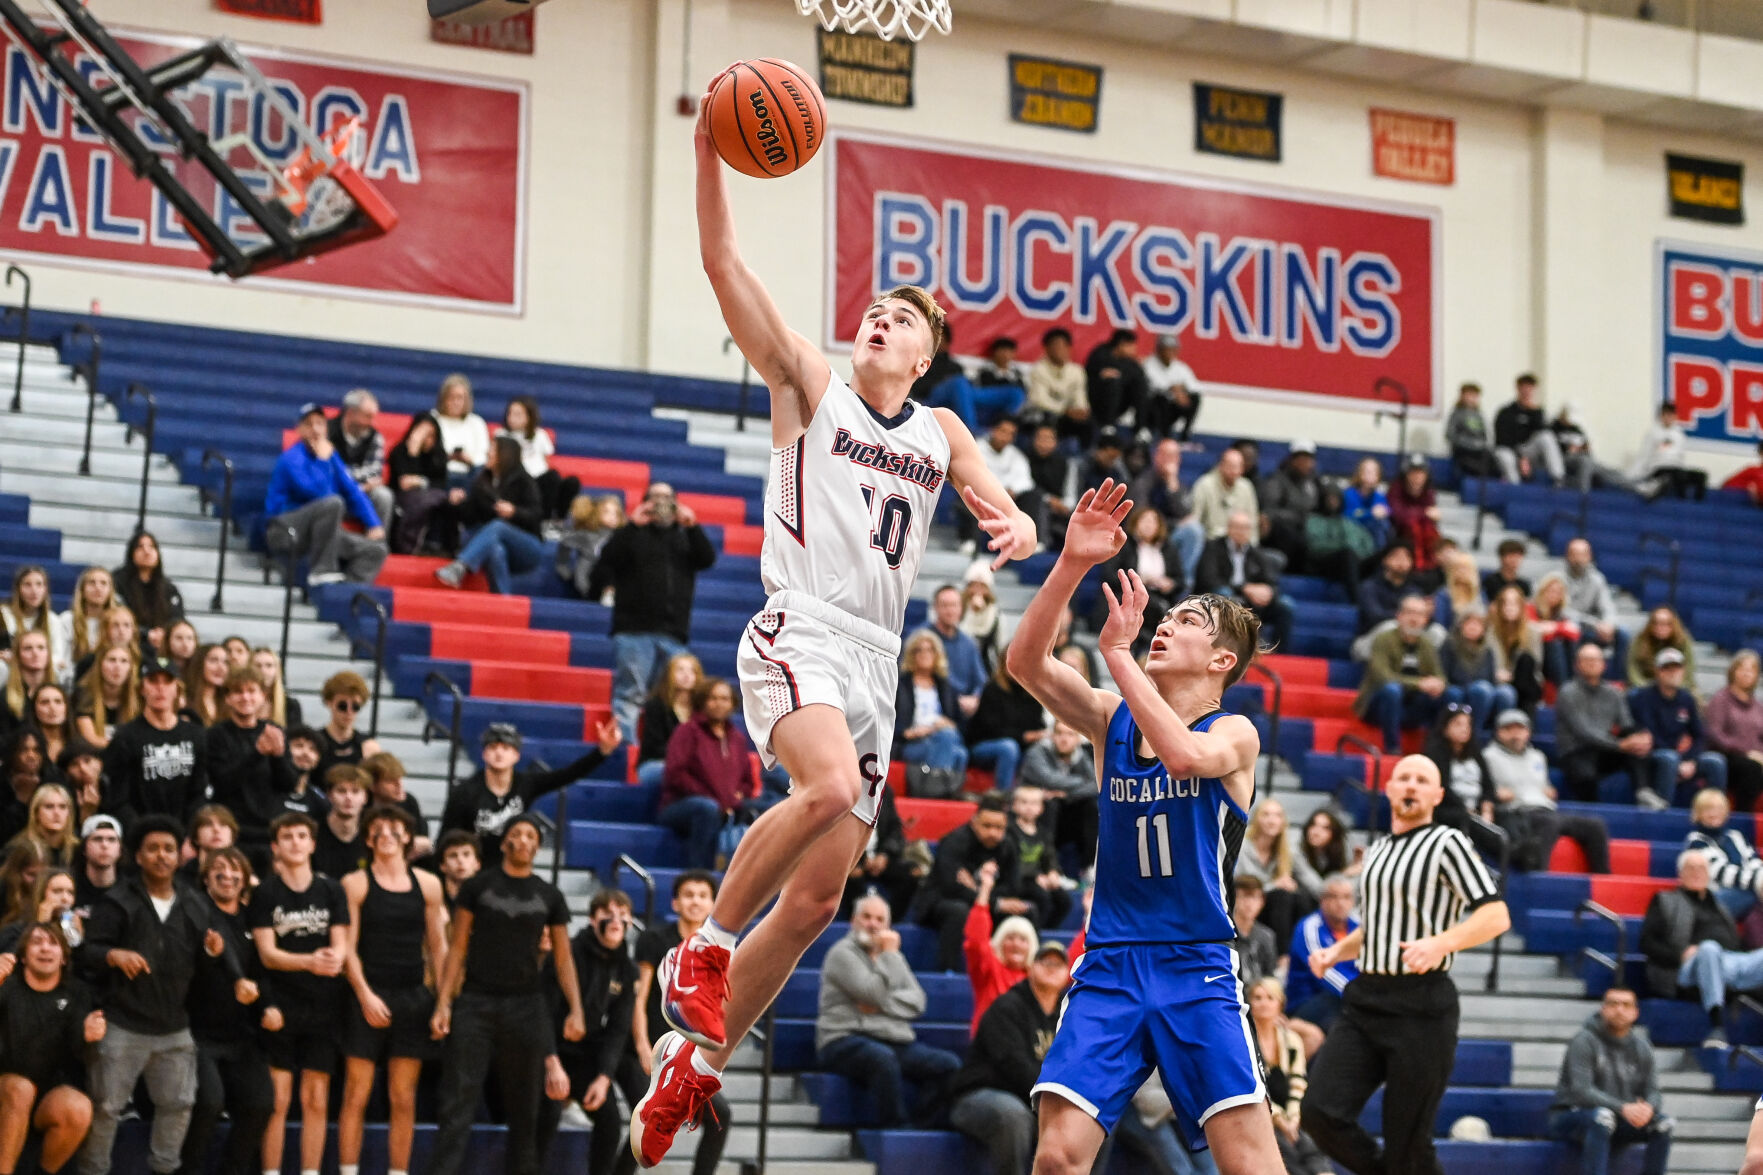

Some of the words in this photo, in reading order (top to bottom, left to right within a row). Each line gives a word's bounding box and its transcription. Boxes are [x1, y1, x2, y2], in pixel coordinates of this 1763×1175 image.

[749, 88, 788, 167] Wilson
[780, 80, 816, 149] EVOLUTION
[872, 190, 1402, 359] BUCKSKINS
[1110, 773, 1200, 803] COCALICO
[1135, 813, 1174, 878] 11
